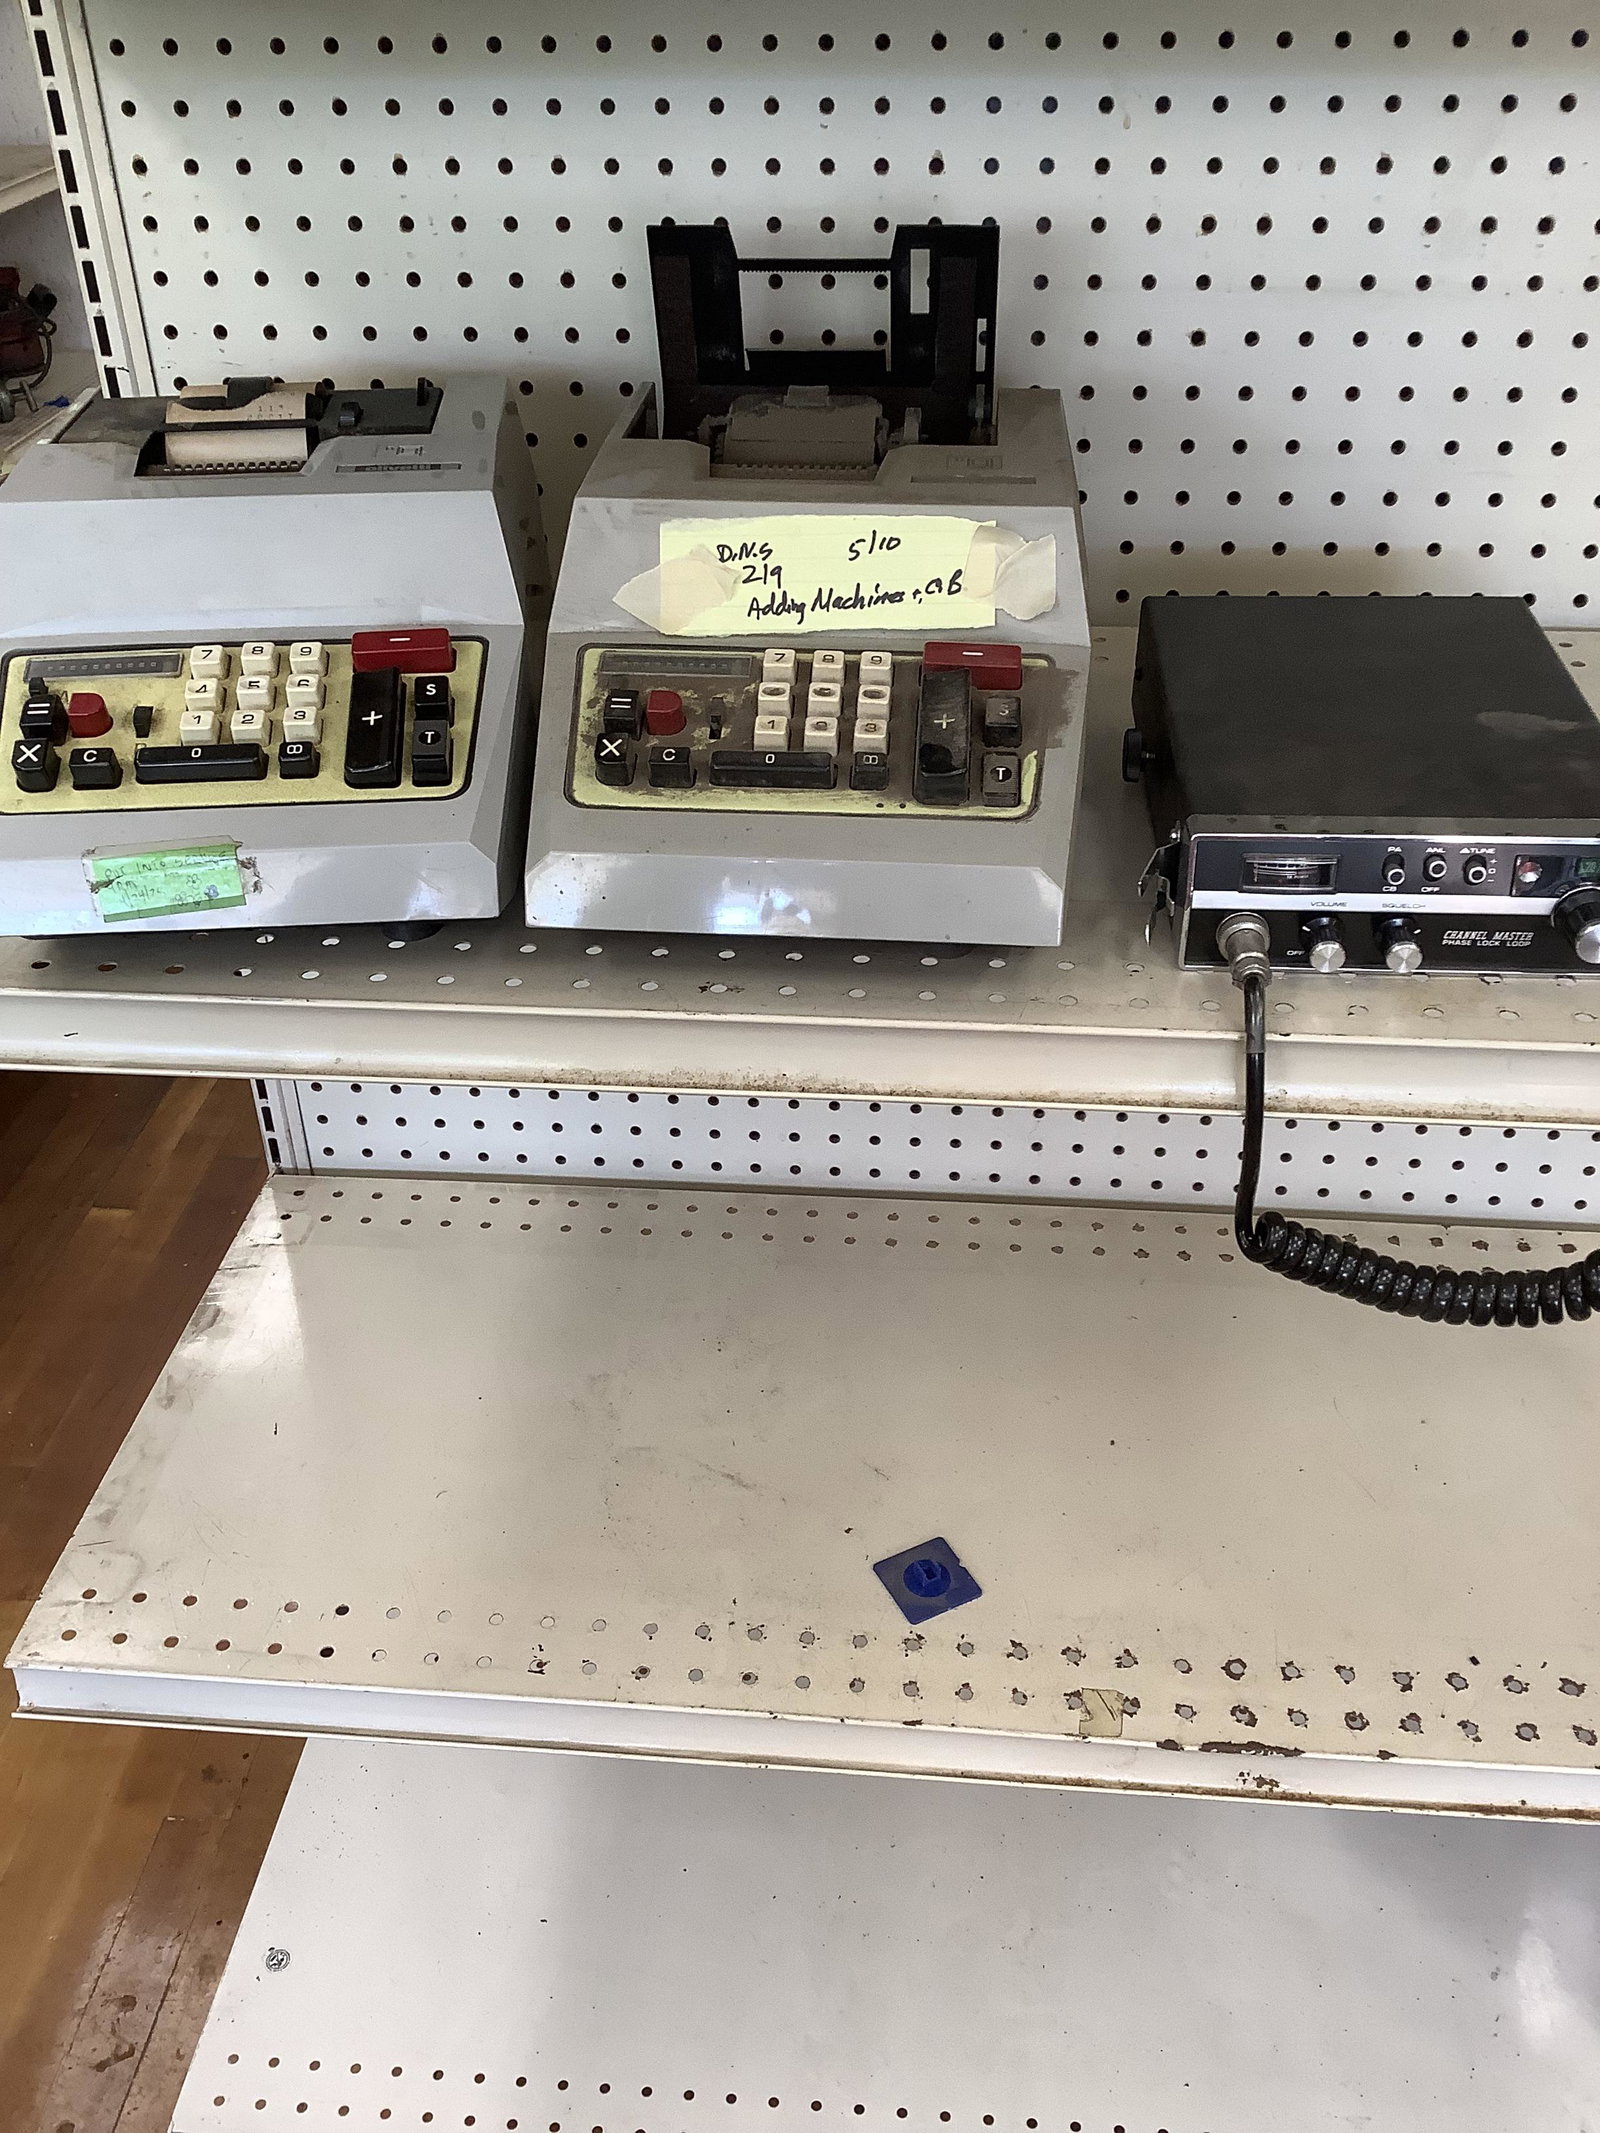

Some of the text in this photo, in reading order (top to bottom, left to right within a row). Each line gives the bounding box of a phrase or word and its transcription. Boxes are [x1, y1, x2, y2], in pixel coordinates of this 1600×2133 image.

[849, 530, 901, 561] 5/10
[747, 591, 806, 625] Adding
[201, 646, 312, 660] 7 8 9
[774, 653, 786, 662] 7
[426, 683, 437, 696] S
[193, 710, 306, 725] 1 2 3
[767, 720, 775, 729] 1
[865, 723, 877, 732] 3
[425, 731, 435, 744] T
[83, 750, 98, 762] C
[662, 748, 676, 761] C
[996, 767, 1006, 781] T
[136, 860, 166, 874] INTO
[1443, 930, 1535, 941] CHANNEL MASTER
